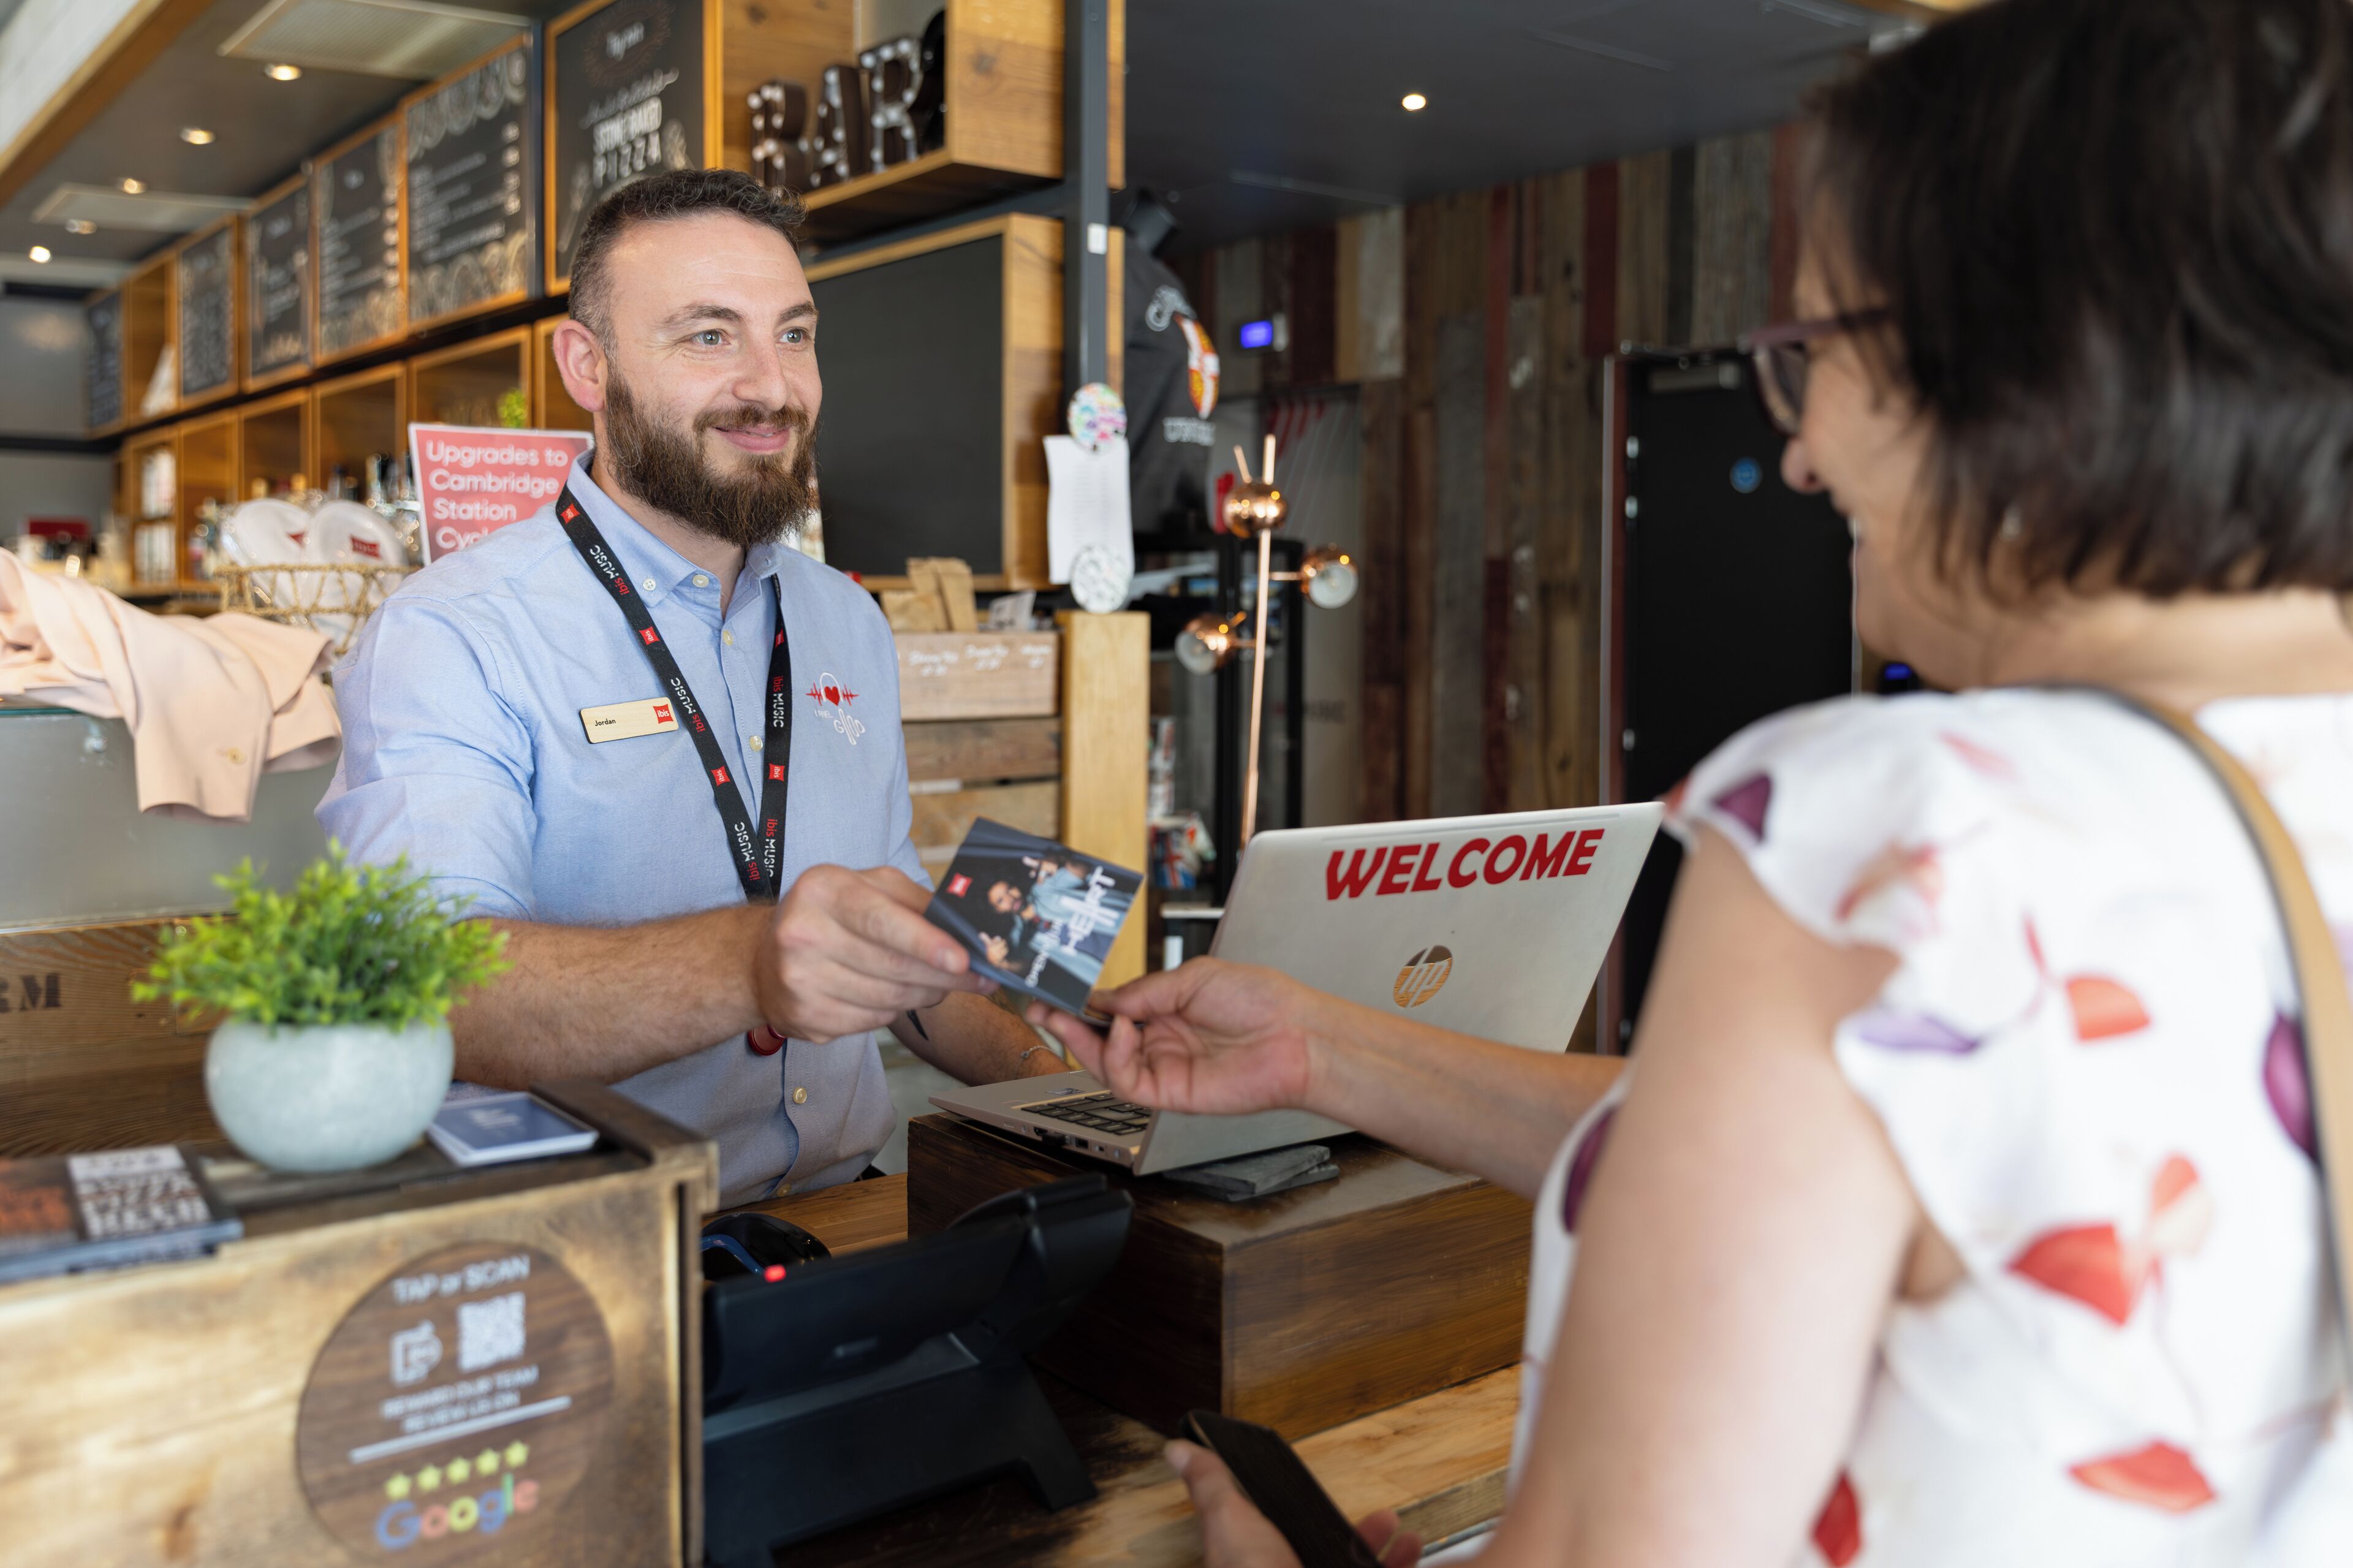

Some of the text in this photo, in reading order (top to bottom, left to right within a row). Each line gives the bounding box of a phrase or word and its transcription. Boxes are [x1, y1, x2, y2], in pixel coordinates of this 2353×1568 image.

[748, 37, 922, 195] BAR
[593, 131, 662, 189] PIZZA
[426, 440, 568, 468] Upgrades to
[429, 468, 559, 498] Cambridge
[433, 498, 517, 521] Station
[589, 545, 630, 596] ibis MUSIC
[645, 630, 654, 642] ibis
[594, 718, 616, 727] Jordan
[656, 709, 670, 718] ibis
[671, 677, 706, 733] ibis MUSIC
[773, 676, 784, 728] ibis MUSIC
[734, 822, 760, 881] ibis MUSIC
[766, 818, 778, 837] ibis
[1325, 828, 1605, 901] WELCOME
[1397, 947, 1450, 1008] hp
[393, 1254, 531, 1304] TAP or SCAN
[375, 1472, 540, 1550] Google
